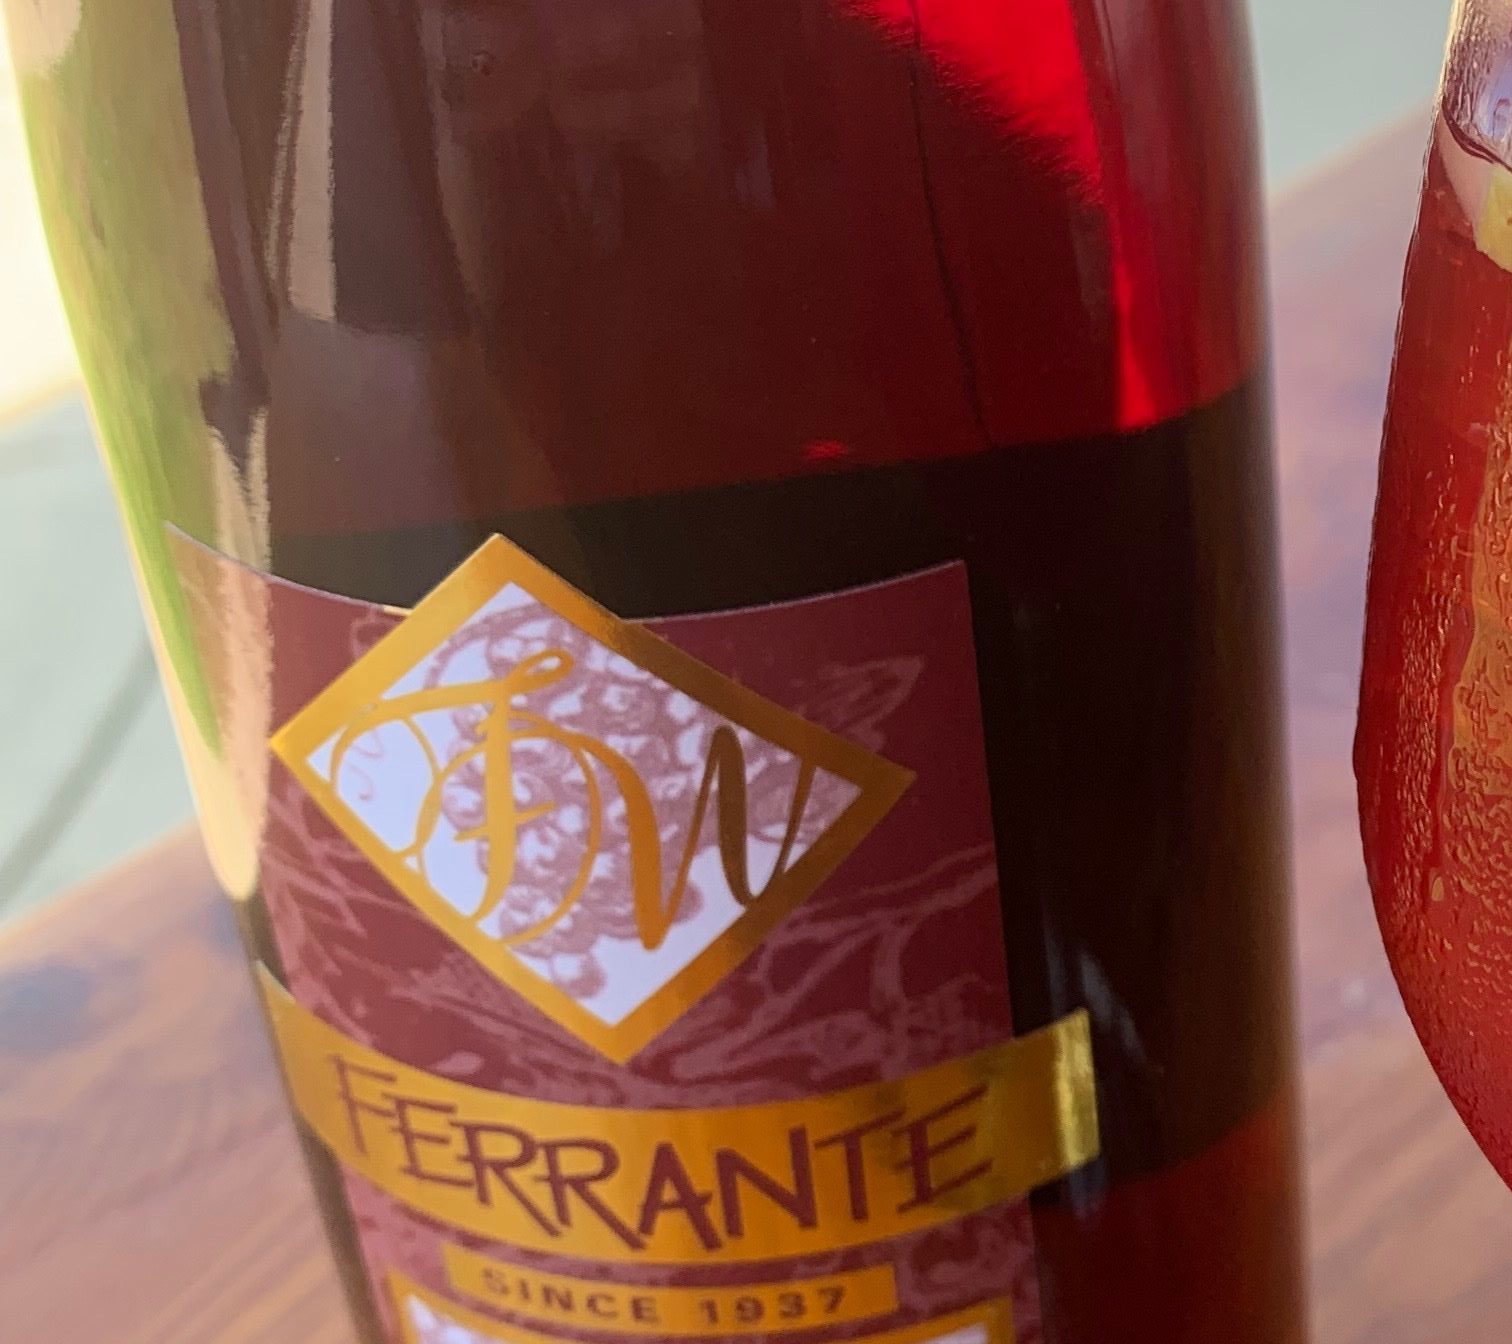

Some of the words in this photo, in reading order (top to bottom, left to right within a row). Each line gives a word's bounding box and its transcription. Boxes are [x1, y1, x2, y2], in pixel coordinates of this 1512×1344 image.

[336, 1059, 994, 1251] FERRANTE
[481, 1265, 660, 1325] SINCE
[702, 1286, 845, 1326] 1937
